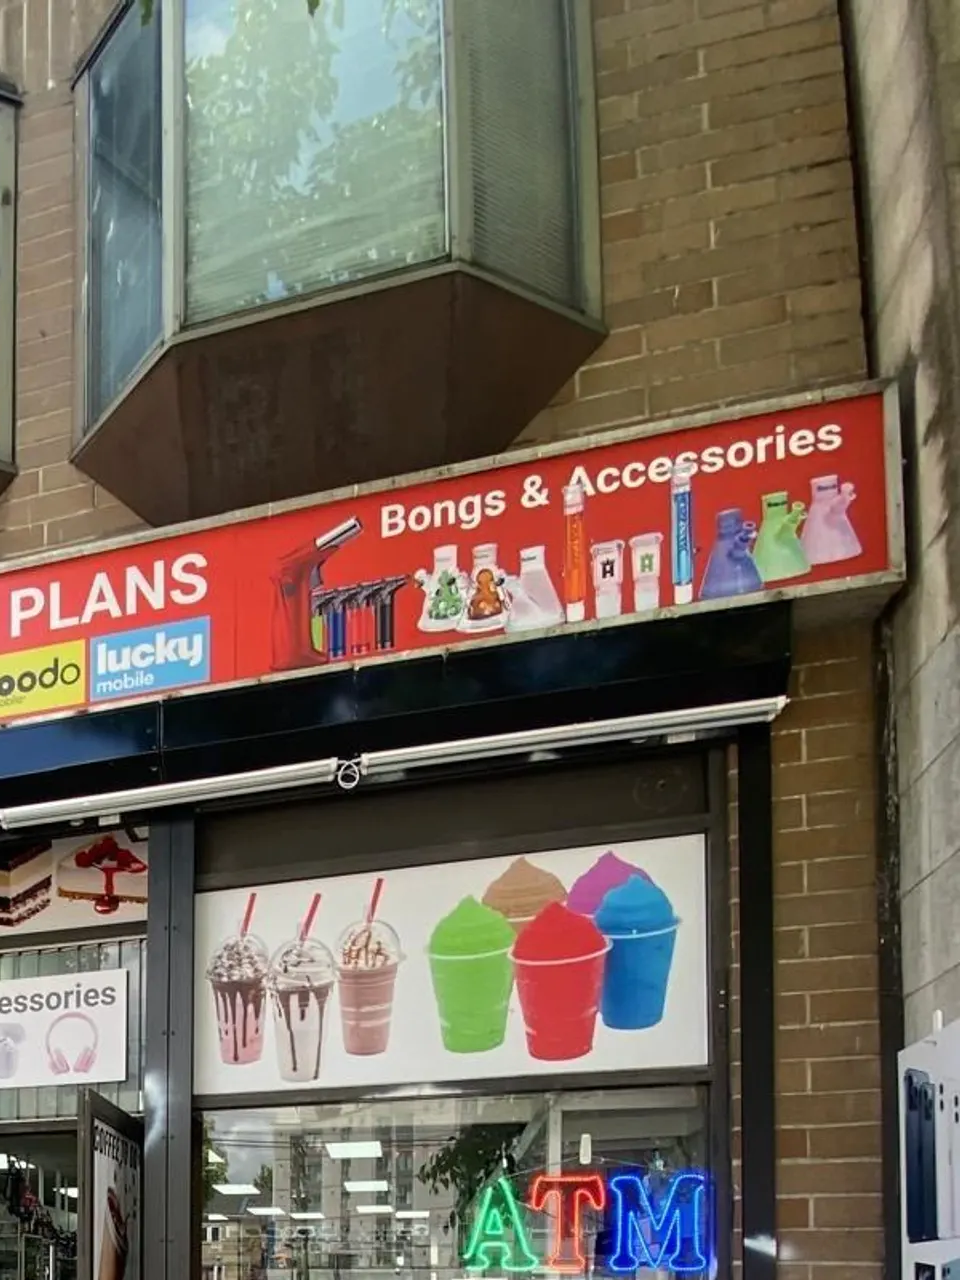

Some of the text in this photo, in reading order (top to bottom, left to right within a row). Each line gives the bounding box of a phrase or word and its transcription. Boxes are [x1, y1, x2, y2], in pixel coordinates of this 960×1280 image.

[381, 423, 842, 538] Bongs & Accessories
[10, 553, 208, 639] PLANS
[96, 670, 154, 694] mobile
[97, 631, 203, 675] lucky
[463, 1173, 707, 1274] ATM
